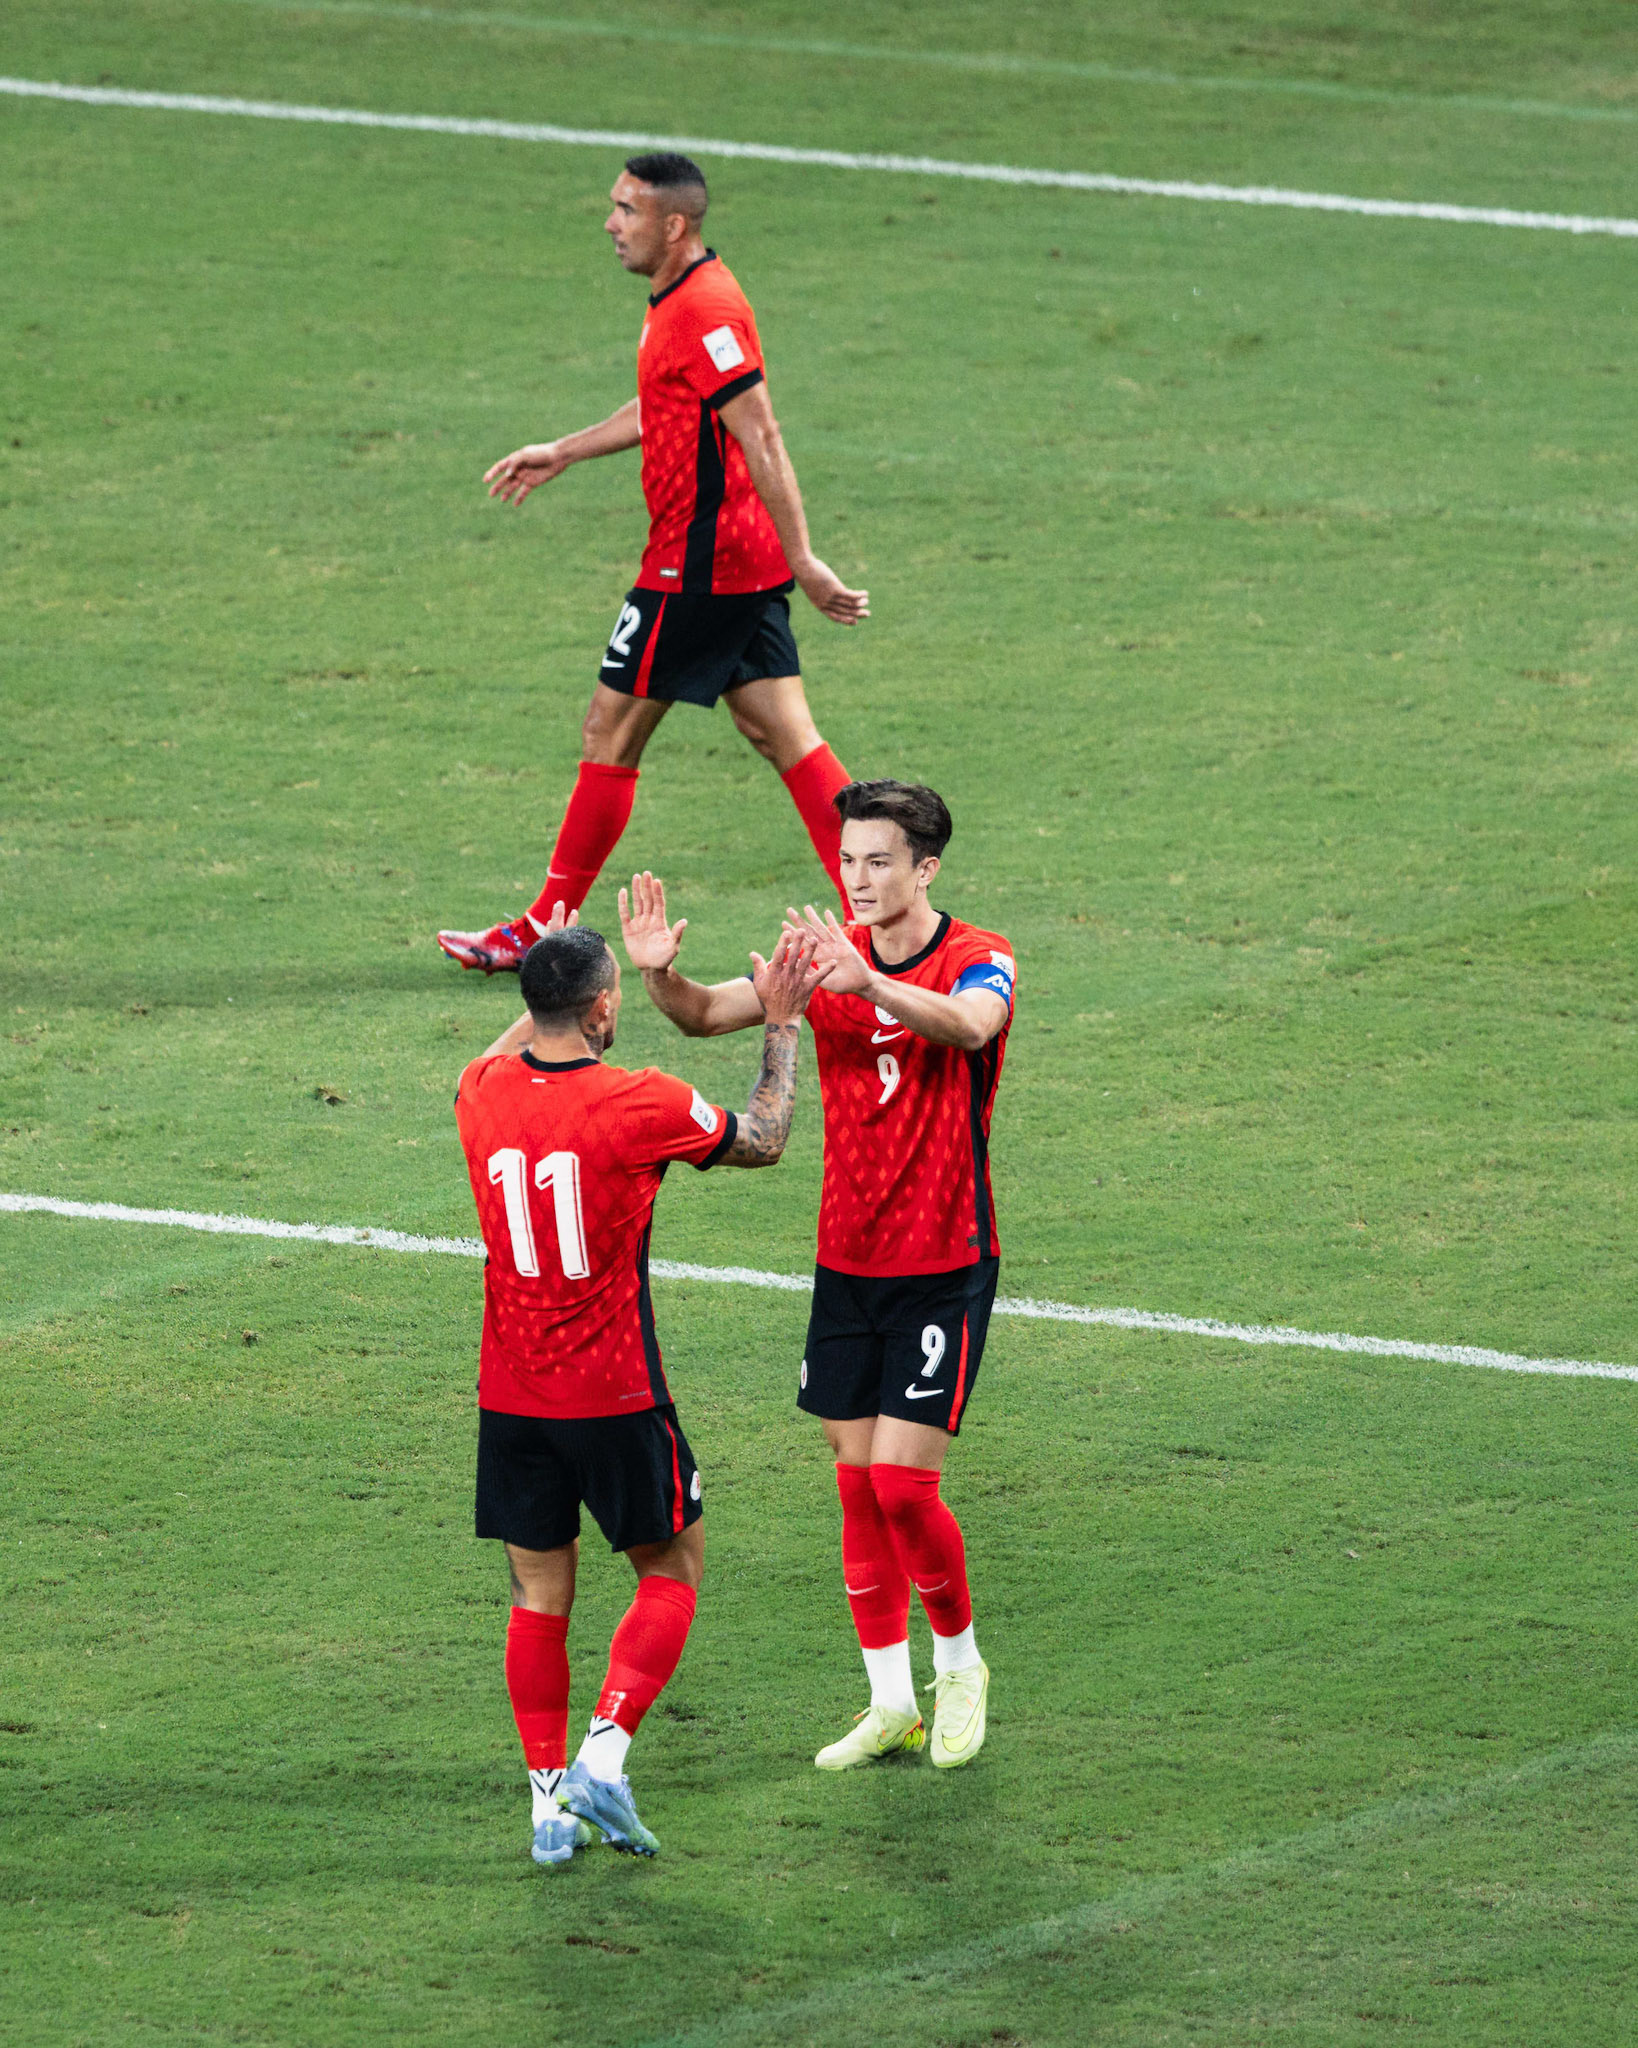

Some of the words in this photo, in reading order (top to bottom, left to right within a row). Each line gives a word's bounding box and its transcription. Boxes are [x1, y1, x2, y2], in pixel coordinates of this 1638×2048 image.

[877, 1054, 900, 1104] 9
[488, 1148, 590, 1280] 11
[921, 1325, 945, 1378] 9
